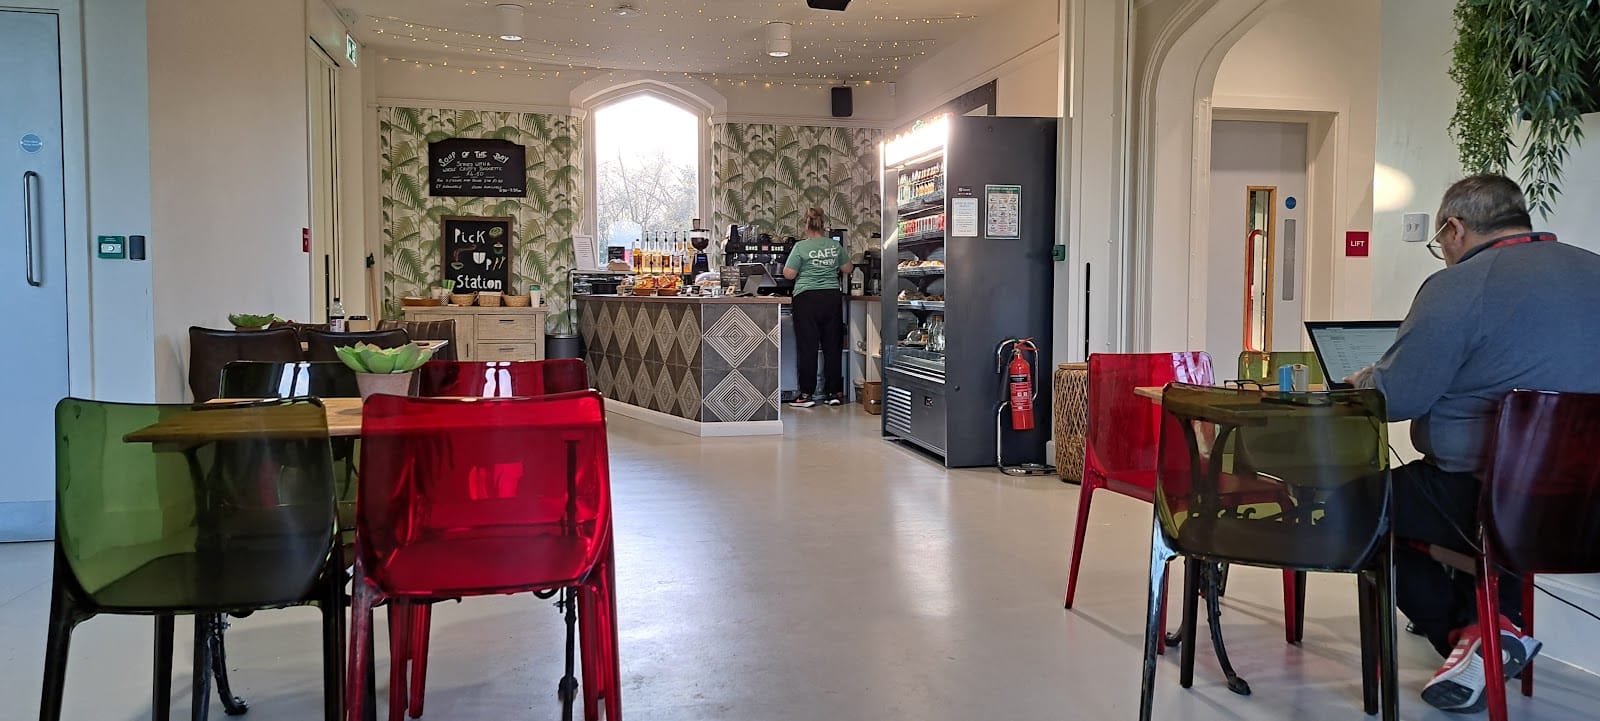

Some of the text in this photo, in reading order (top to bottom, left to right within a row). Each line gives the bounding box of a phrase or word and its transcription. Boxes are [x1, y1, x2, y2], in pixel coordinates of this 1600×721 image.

[474, 150, 488, 158] THE
[808, 245, 838, 258] CAFÉ
[456, 275, 502, 290] Station
